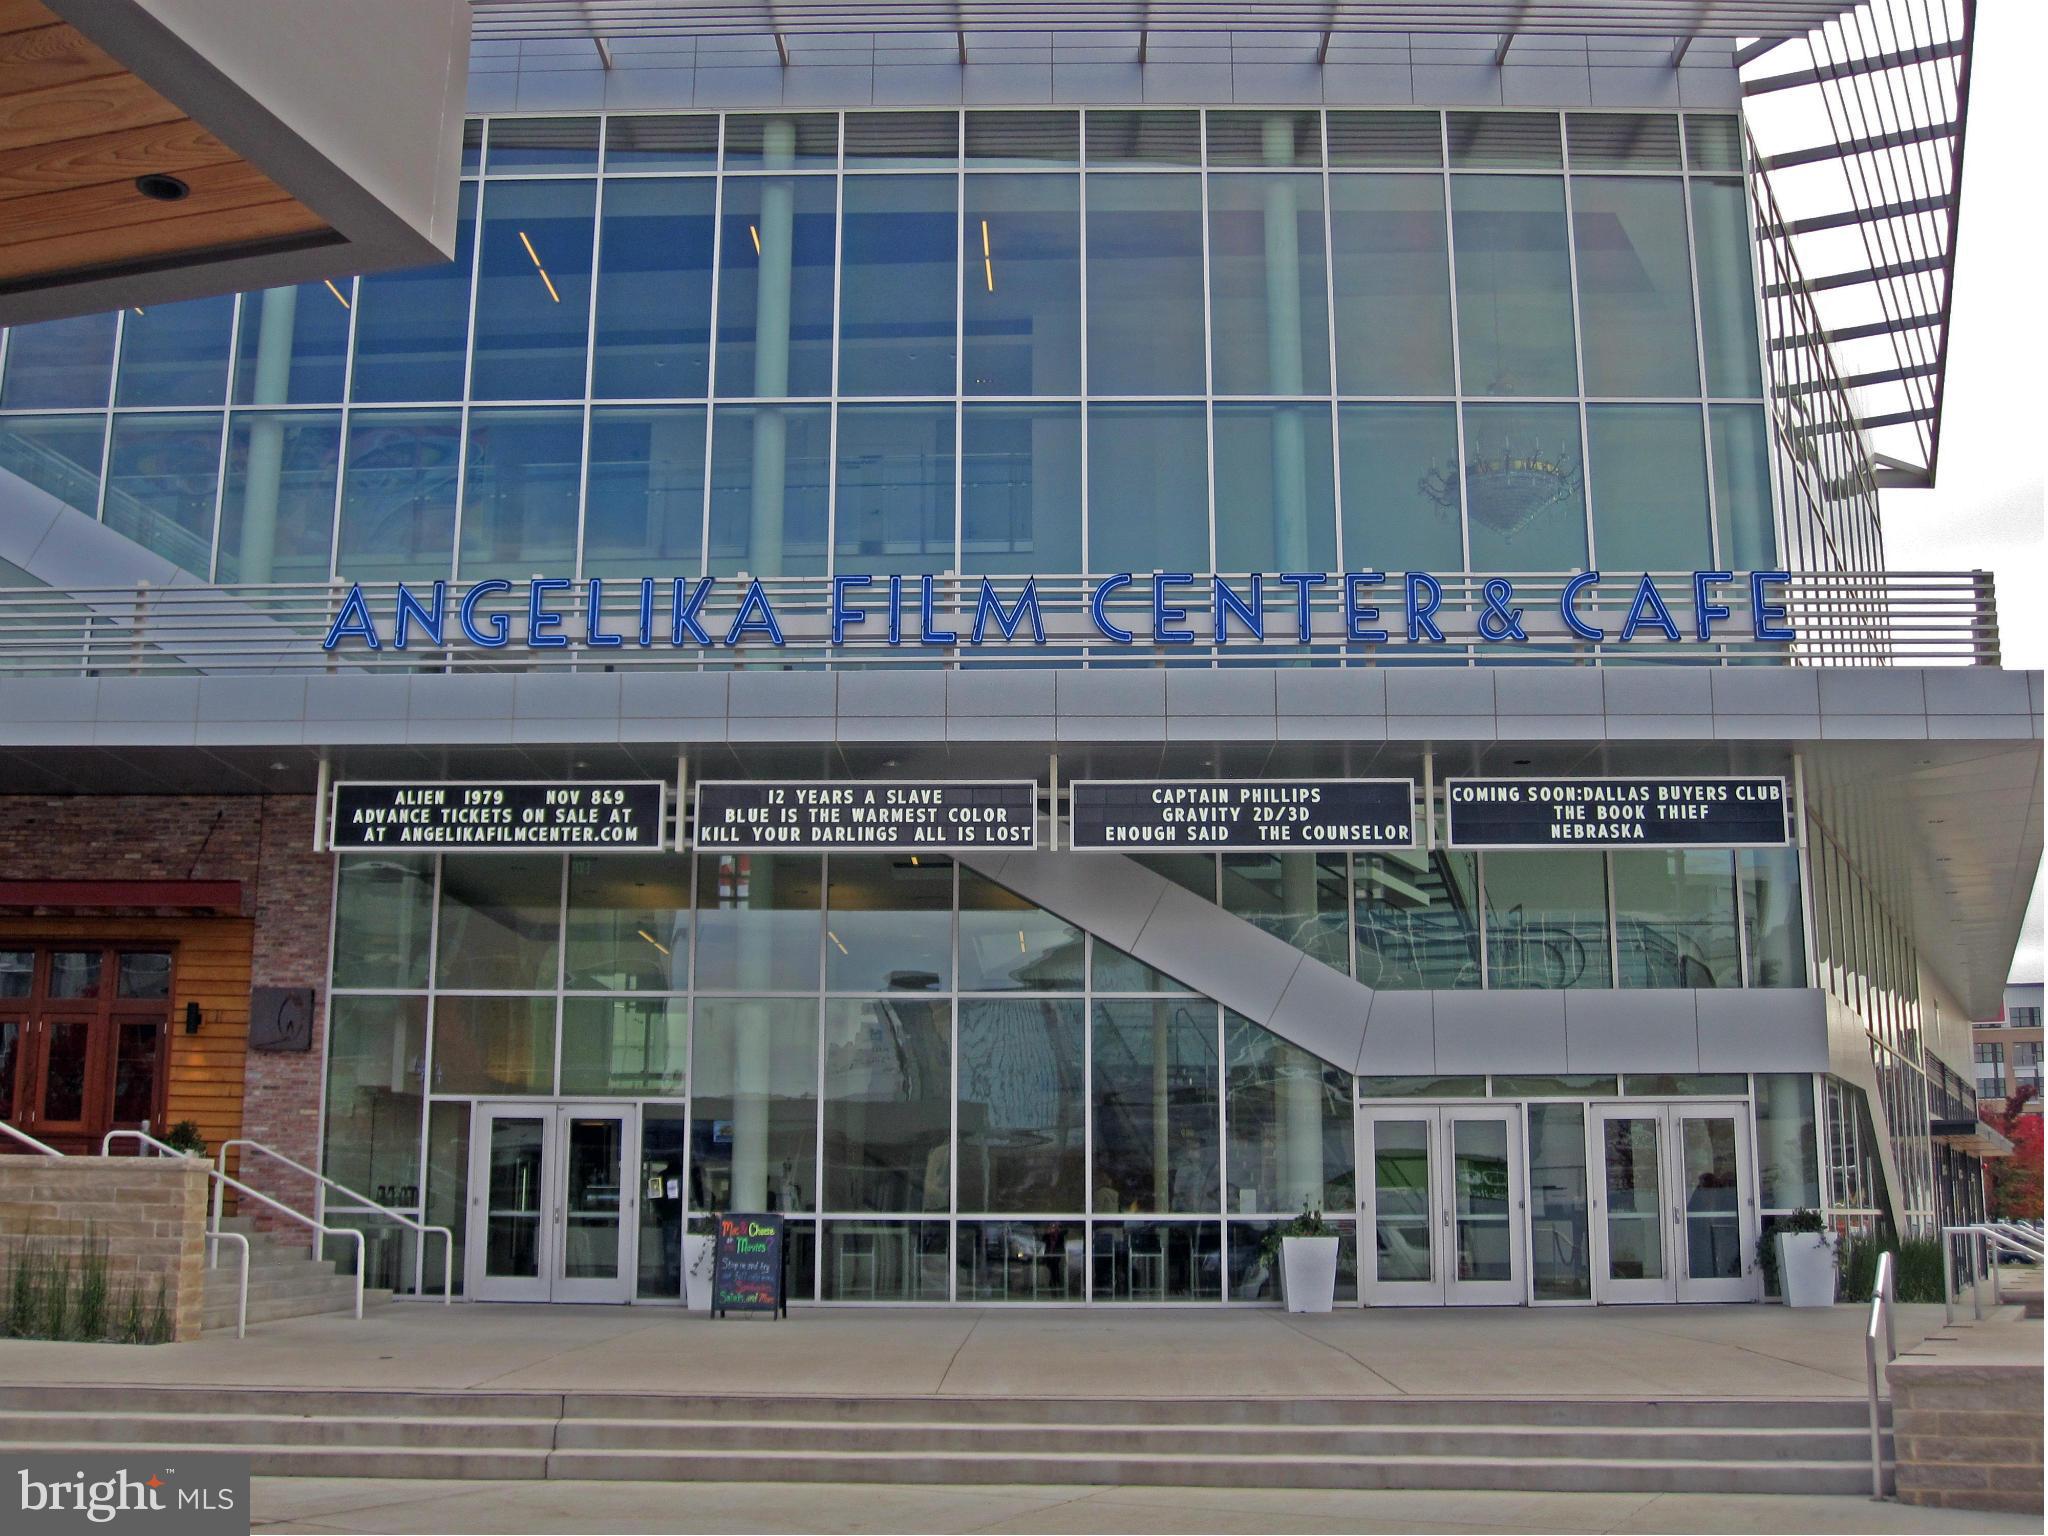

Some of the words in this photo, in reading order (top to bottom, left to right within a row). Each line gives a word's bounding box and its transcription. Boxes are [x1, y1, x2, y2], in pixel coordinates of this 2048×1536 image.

[322, 576, 785, 650] ANGELIKA
[831, 574, 1047, 646] FILM
[1091, 571, 1447, 643] CENTER
[1478, 577, 1529, 641] &
[1560, 571, 1797, 641] CAFE
[395, 791, 444, 805] ALIEN
[465, 791, 503, 804] 1979
[546, 791, 580, 804] NOV
[591, 790, 624, 804] 8&9
[769, 790, 784, 804] 12
[796, 790, 853, 804] YEARS
[865, 790, 875, 804] A
[887, 790, 941, 804] SLAVE
[1152, 789, 1228, 803] CAPTAIN
[1241, 788, 1320, 803] PHILLIPS
[1453, 787, 1519, 801] COMING
[1528, 787, 1649, 801] SOON:DALLAS
[1659, 786, 1726, 800] BUYERS
[1736, 786, 1779, 800] CLUB
[353, 809, 429, 823] ADVANCE
[441, 809, 511, 823] TICKETS
[523, 809, 544, 823] ON
[556, 809, 598, 823] SALE
[610, 809, 631, 823] AT
[726, 808, 768, 822] BLUE
[781, 808, 797, 822] IS
[809, 809, 839, 822] THE
[852, 808, 937, 822] WARMEST
[949, 808, 1006, 822] COLOR
[1163, 807, 1240, 822] GRAVITY
[1254, 807, 1309, 821] 2D/3D
[1554, 806, 1585, 819] THE
[1598, 805, 1645, 819] BOOK
[1657, 805, 1708, 819] THIEF
[364, 827, 386, 841] AT
[401, 827, 637, 841] ANGELIKAFILMCENTER.COM
[702, 827, 739, 841] KILL
[753, 827, 800, 841] YOUR
[812, 827, 897, 841] DARLINGS
[914, 827, 946, 841] ALL
[959, 827, 974, 841] IS
[987, 827, 1030, 841] LOST
[1106, 826, 1175, 840] ENOUGH
[1188, 826, 1228, 840] SAID
[1259, 826, 1290, 840] THE
[1303, 825, 1408, 840] COUNSELOR
[1552, 824, 1644, 838] NEBRASKA
